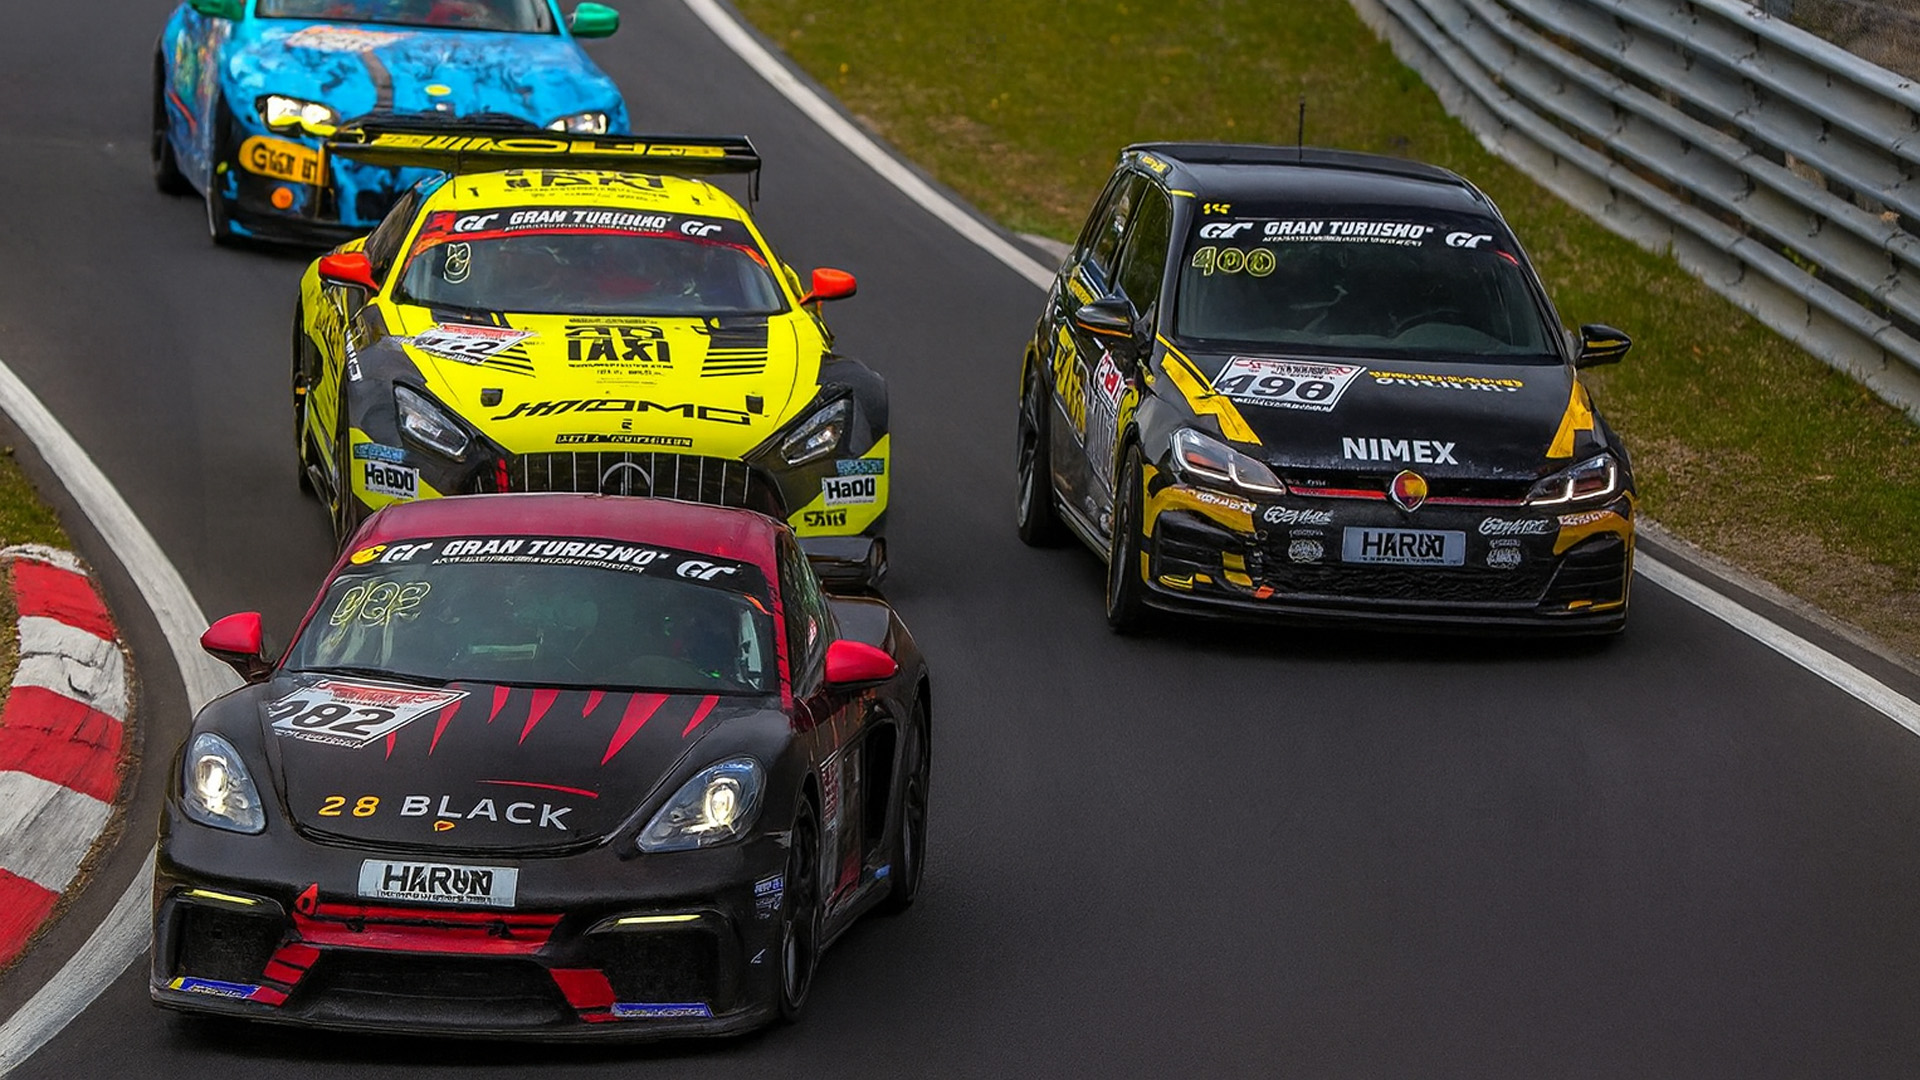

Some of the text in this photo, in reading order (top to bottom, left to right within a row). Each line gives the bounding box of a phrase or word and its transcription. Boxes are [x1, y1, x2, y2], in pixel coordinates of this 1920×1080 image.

[1342, 436, 1459, 465] NIMEX
[441, 539, 525, 556] GRAN
[317, 795, 573, 831] 28 BLACK
